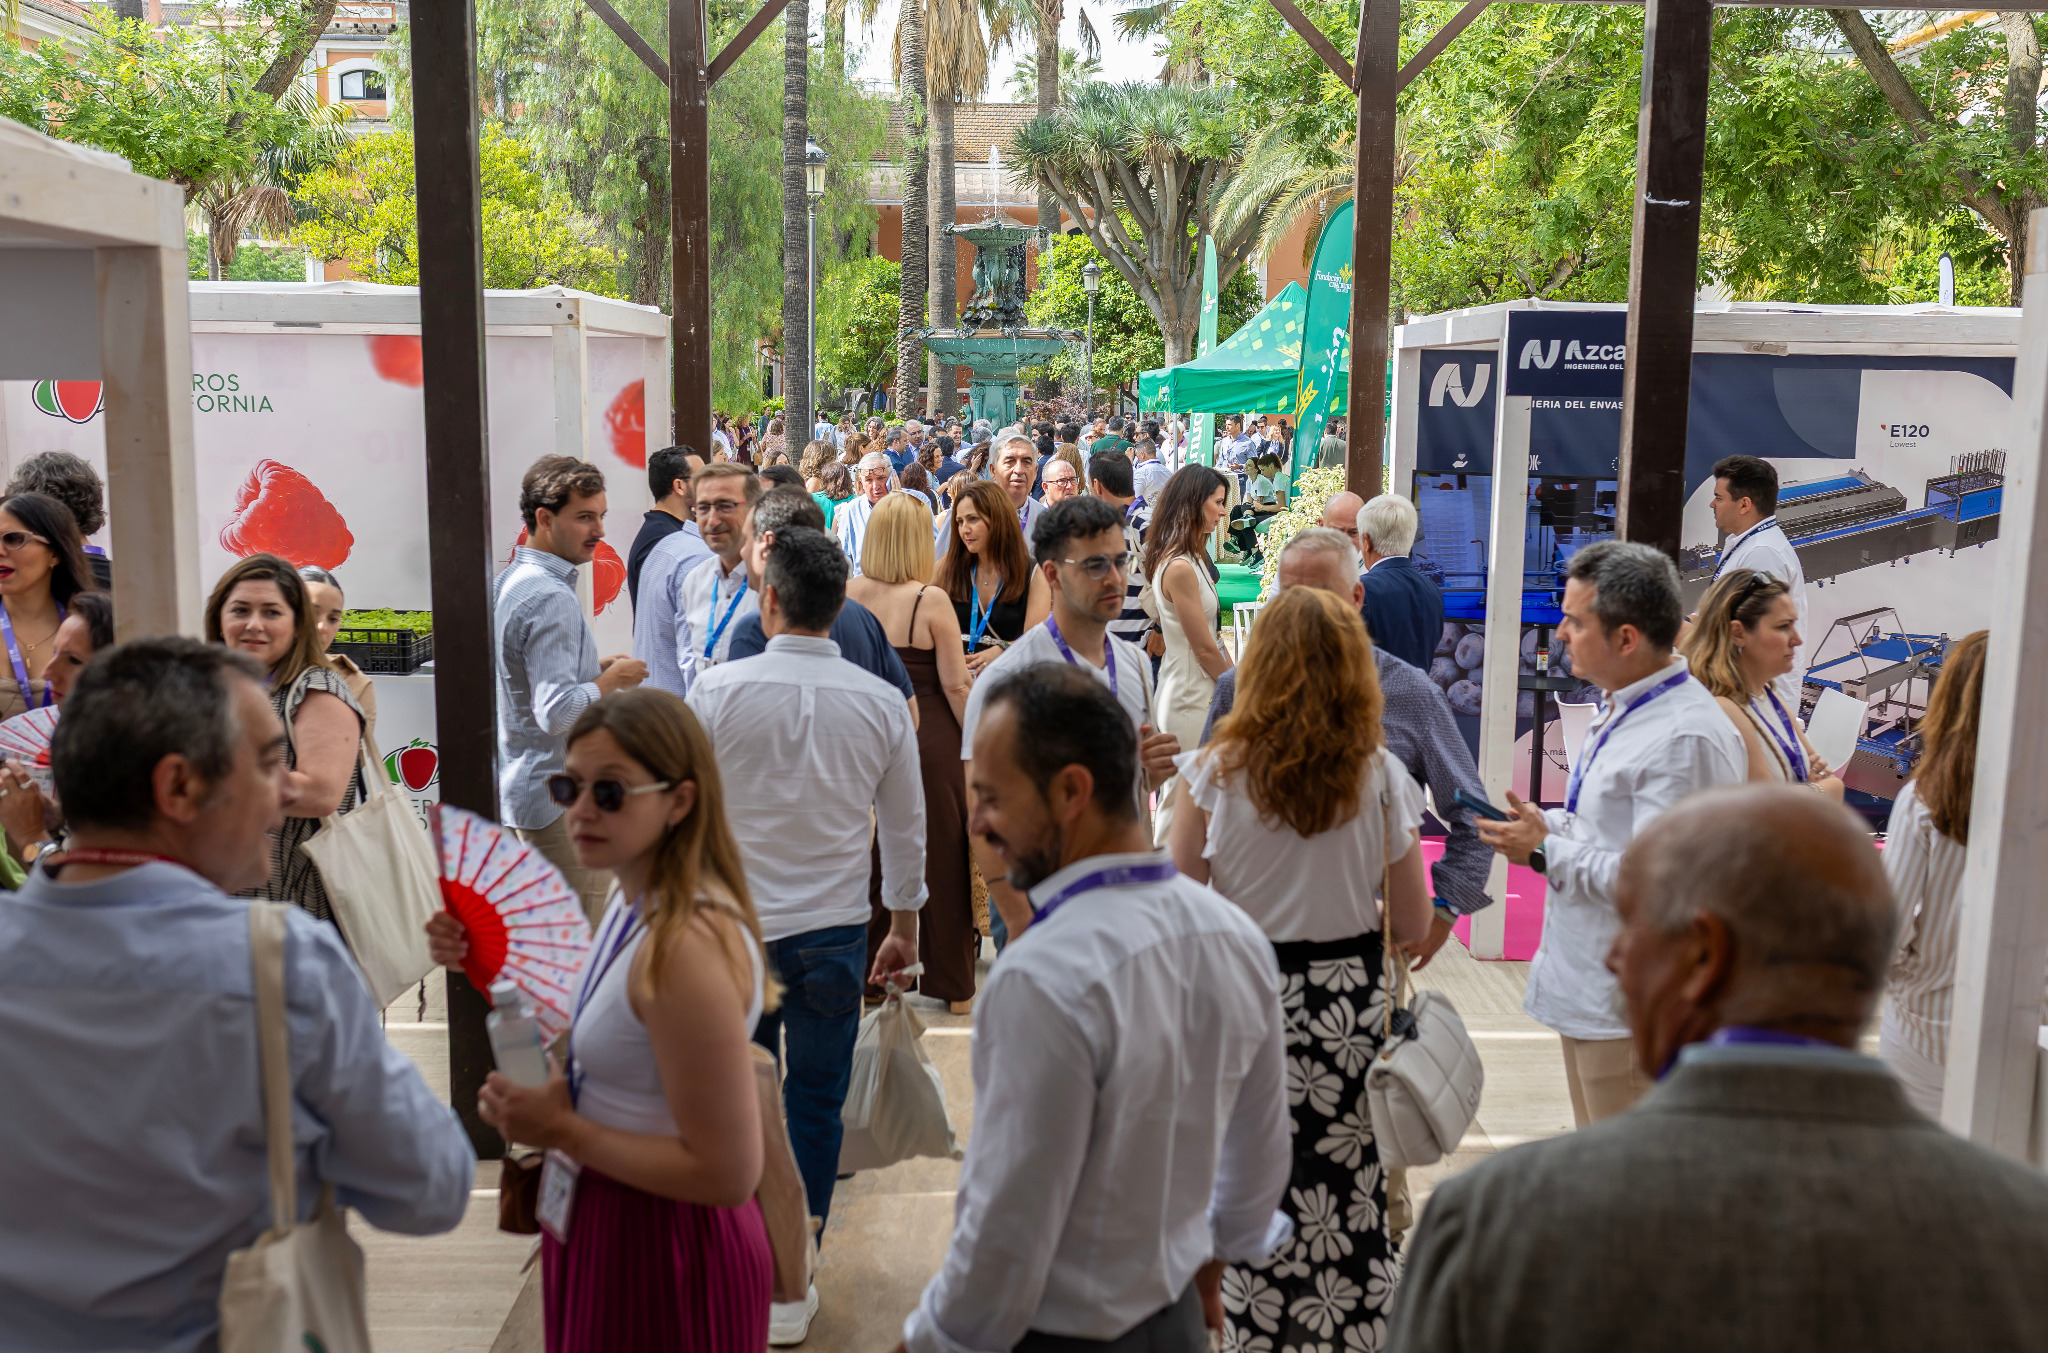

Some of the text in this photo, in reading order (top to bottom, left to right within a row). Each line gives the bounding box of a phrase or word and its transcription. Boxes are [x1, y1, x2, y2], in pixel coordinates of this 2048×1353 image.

[192, 373, 240, 392] ROS
[1564, 400, 1586, 409] DEL
[1890, 424, 1930, 438] E120
[1889, 440, 1917, 448] Lowest
